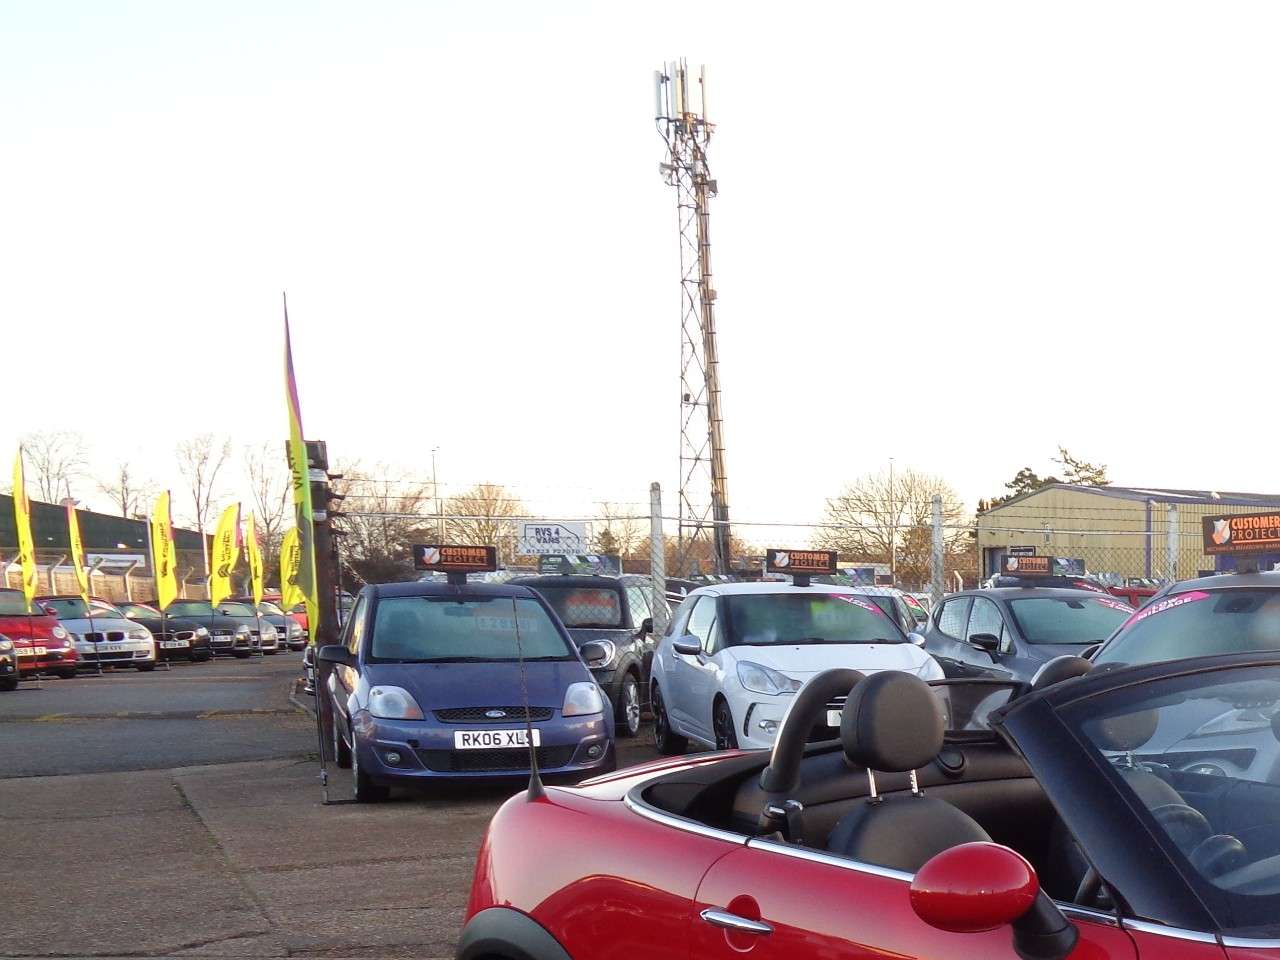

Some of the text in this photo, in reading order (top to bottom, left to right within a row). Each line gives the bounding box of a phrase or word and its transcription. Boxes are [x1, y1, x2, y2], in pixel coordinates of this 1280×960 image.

[1231, 515, 1280, 529] CUSTOMER
[535, 528, 560, 537] RVS 4
[536, 536, 561, 544] VANS
[441, 547, 488, 556] CUSTOMER
[790, 552, 830, 561] CUSTOMER
[462, 733, 502, 746] RK06
